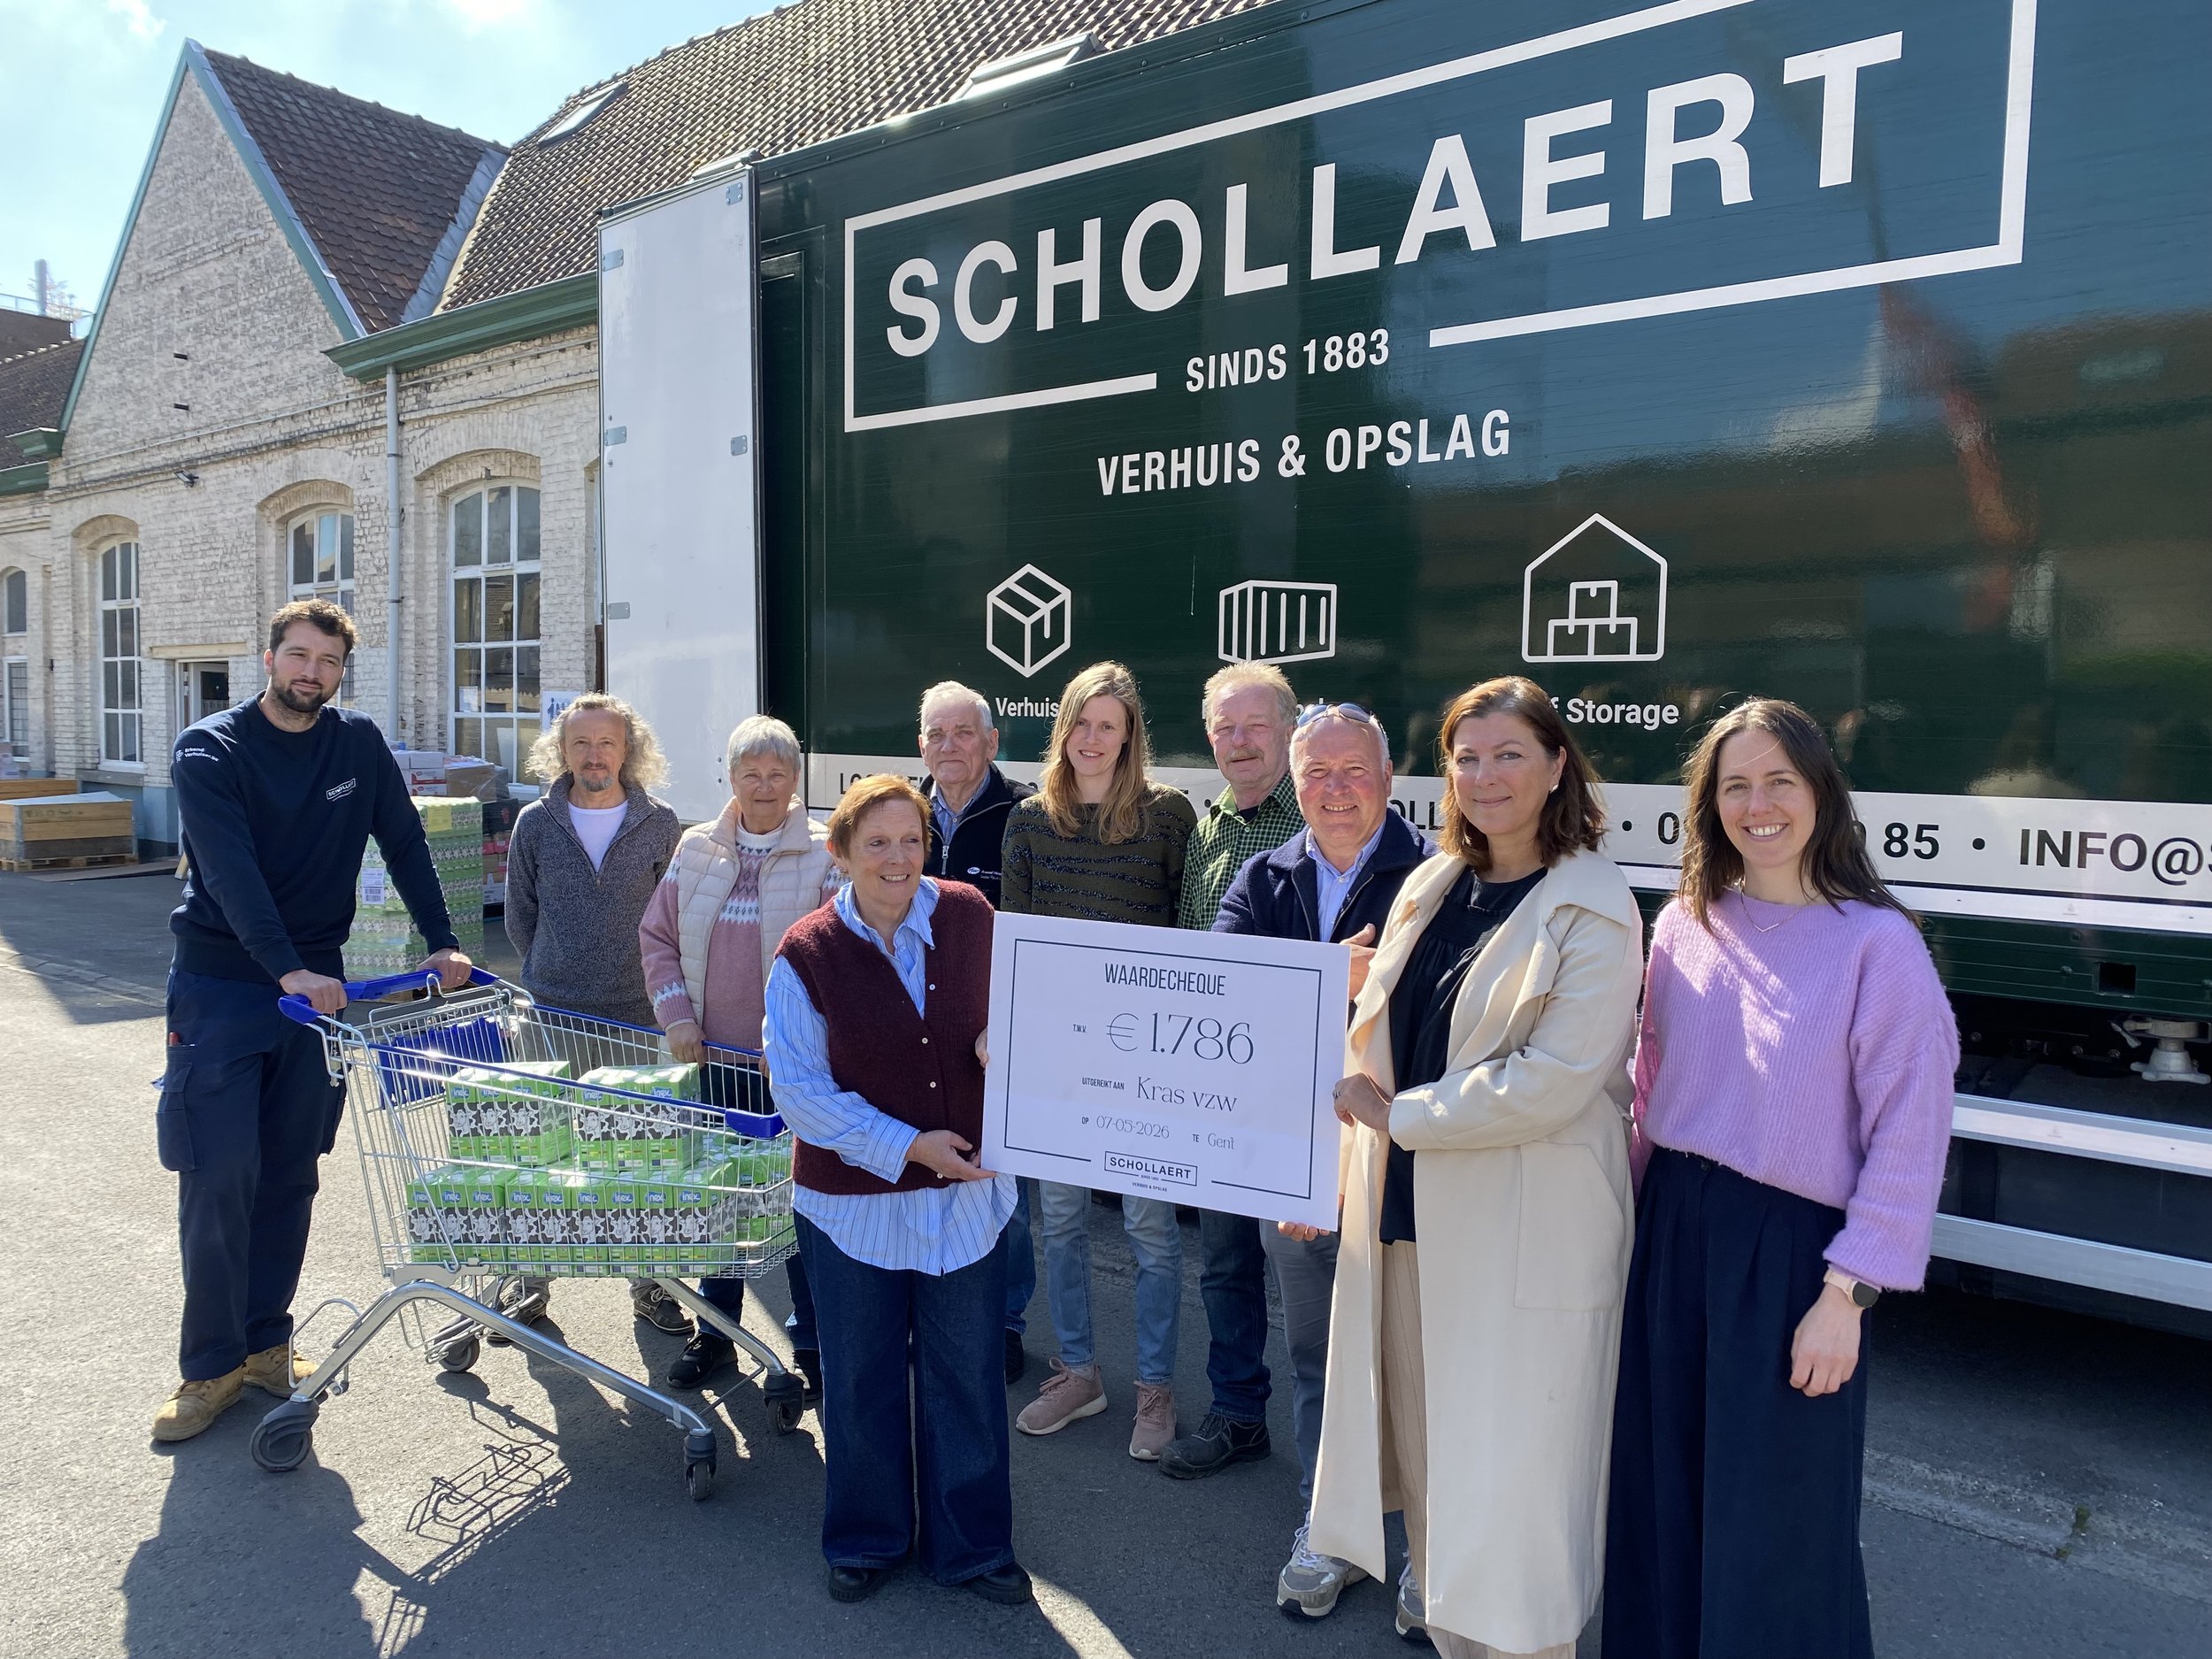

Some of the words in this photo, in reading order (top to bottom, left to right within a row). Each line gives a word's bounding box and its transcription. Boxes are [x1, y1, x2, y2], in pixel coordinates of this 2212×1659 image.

[887, 31, 1902, 357] SCHOLLAERT
[1186, 343, 1286, 392] SINDS
[1302, 328, 1390, 375] 1883
[1097, 439, 1260, 495] VERHUIS
[1278, 434, 1306, 478] &
[1325, 409, 1509, 472] OPSLAG
[1566, 697, 1679, 731] Storage
[1883, 822, 1939, 860] 85
[2020, 828, 2212, 886] INFO@
[1105, 963, 1226, 996] WAARDECHEQUE
[1150, 1011, 1254, 1064] 1.786
[1081, 1077, 1113, 1089] UITGEREIKT
[1112, 1081, 1125, 1090] AAN
[1137, 1076, 1185, 1105] Kras
[1192, 1091, 1238, 1112] vzw
[1081, 1116, 1089, 1125] OP
[1096, 1115, 1170, 1140] 07-05-2026
[1192, 1133, 1200, 1143] TE
[1207, 1133, 1235, 1150] Gent
[1110, 1156, 1192, 1179] SCHOLLAERT
